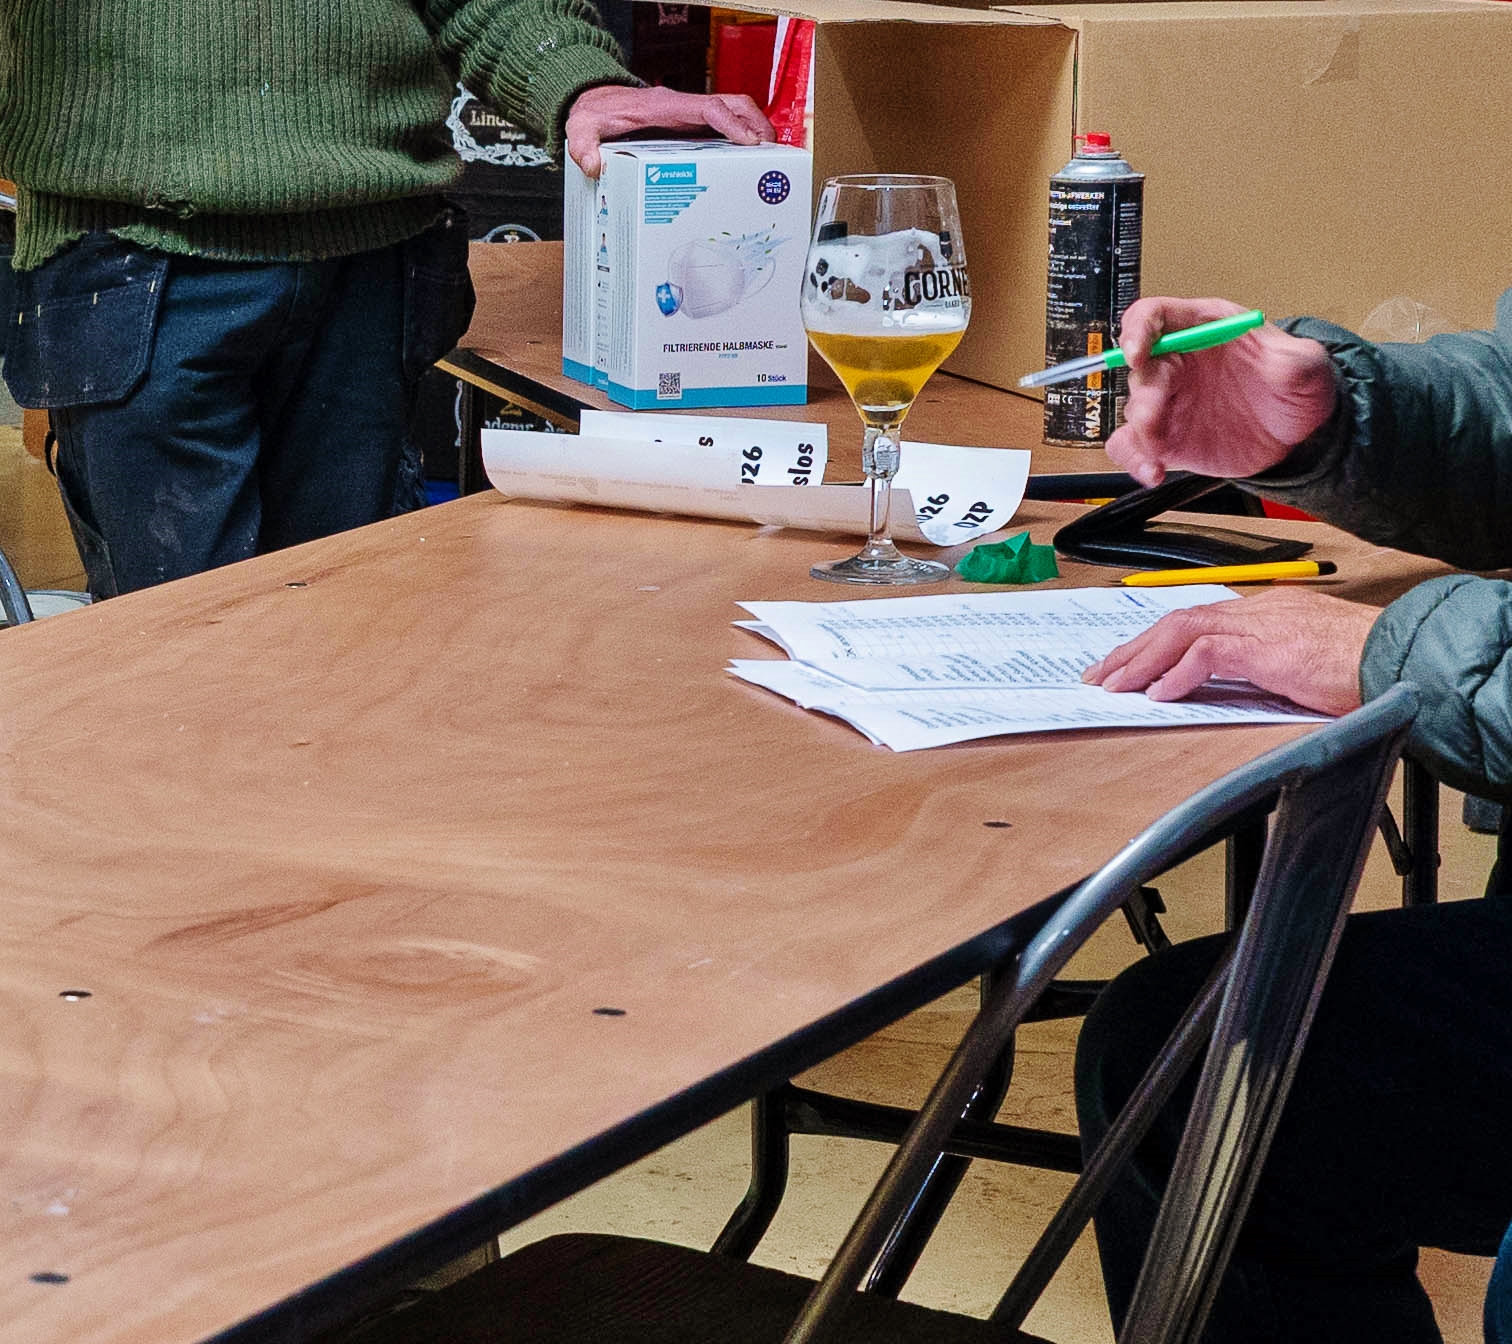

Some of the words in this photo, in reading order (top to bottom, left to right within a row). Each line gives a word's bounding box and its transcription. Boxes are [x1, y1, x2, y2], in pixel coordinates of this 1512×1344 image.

[663, 342, 721, 353] FILTRIERENDE
[722, 340, 774, 351] HALBMASKE
[756, 373, 767, 383] 10
